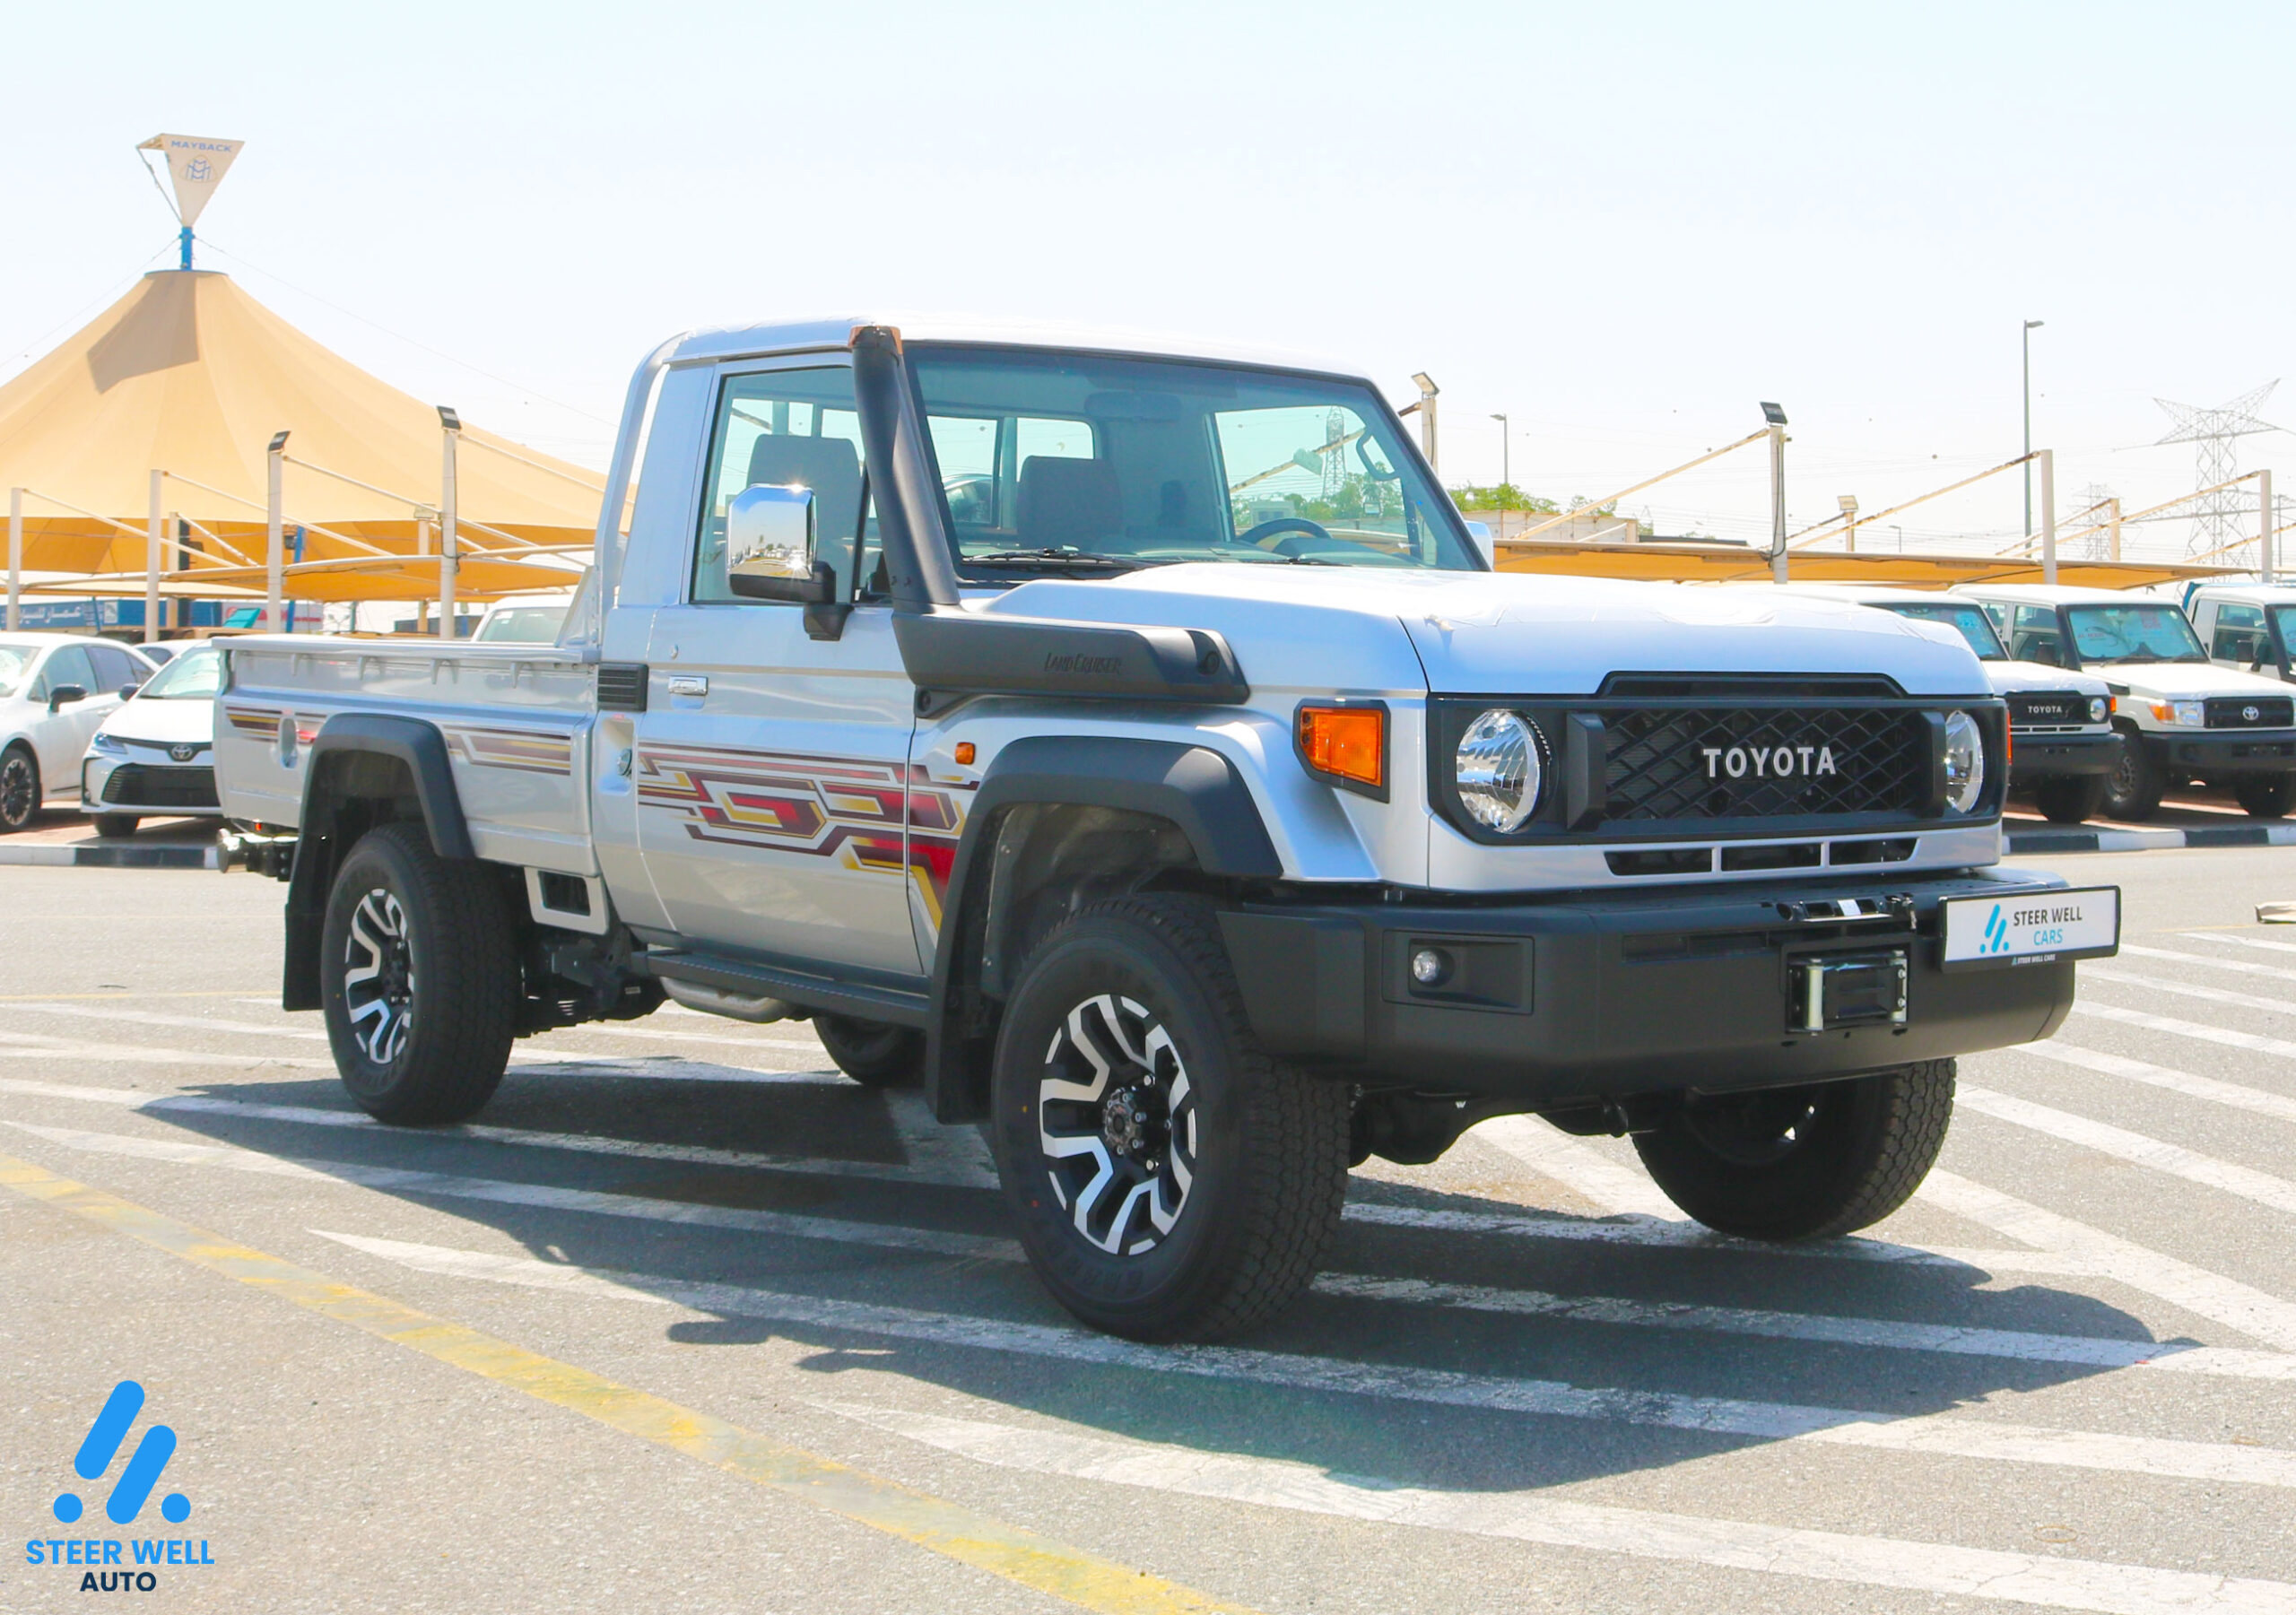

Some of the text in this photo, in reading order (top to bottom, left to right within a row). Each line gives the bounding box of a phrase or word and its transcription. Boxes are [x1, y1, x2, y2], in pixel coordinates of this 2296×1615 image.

[170, 140, 232, 152] MAYBACK
[2028, 705, 2063, 714] TOYOTA
[1702, 746, 1837, 778] TOYOTA
[2013, 906, 2083, 926] STEER WELL
[2033, 928, 2064, 946] CARS
